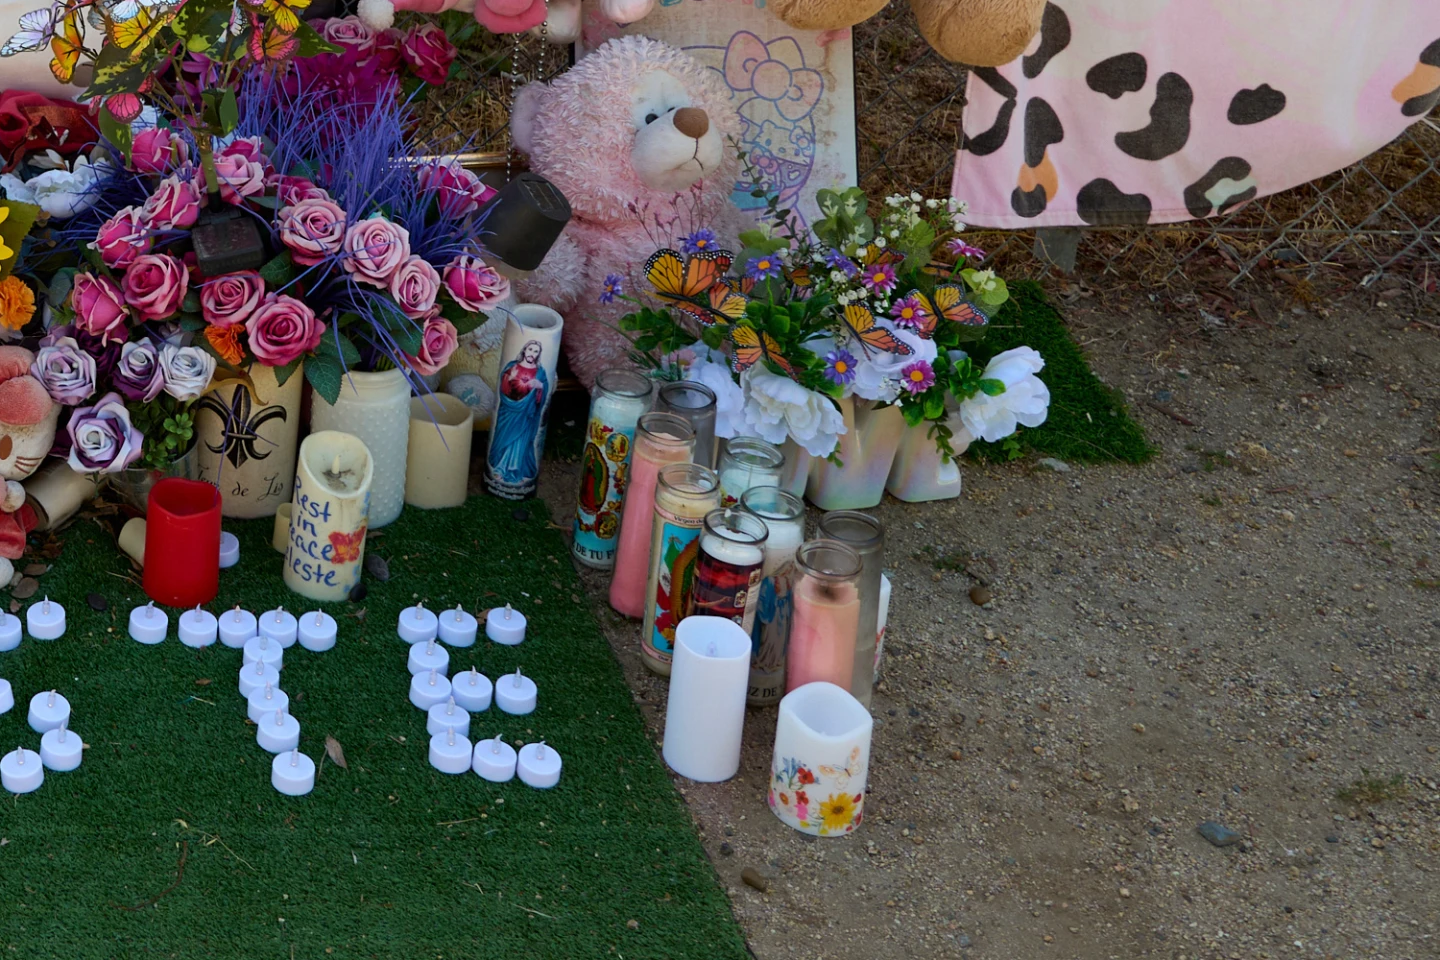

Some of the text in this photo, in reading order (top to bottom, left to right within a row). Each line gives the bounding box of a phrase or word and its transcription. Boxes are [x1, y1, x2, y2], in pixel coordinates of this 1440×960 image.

[294, 474, 332, 523] Rest
[289, 522, 334, 563] eace
[297, 511, 318, 537] in
[284, 545, 341, 588] eleste
